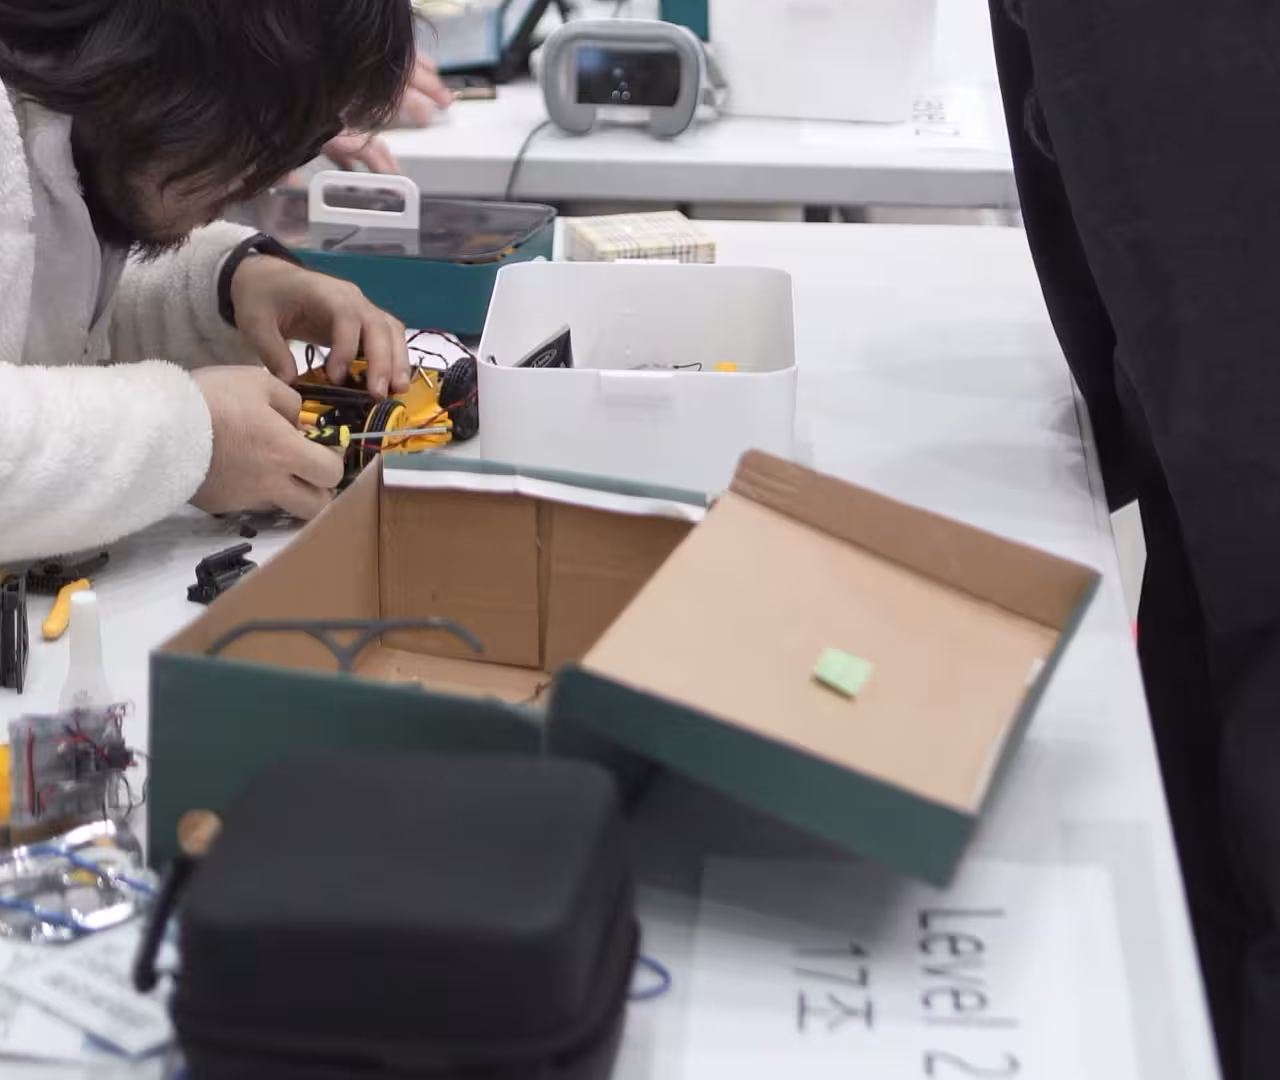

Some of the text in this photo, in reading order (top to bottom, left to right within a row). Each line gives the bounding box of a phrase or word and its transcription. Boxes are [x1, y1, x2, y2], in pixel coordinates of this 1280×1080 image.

[792, 941, 875, 1034] 17조
[916, 906, 1022, 1080] Level 2
